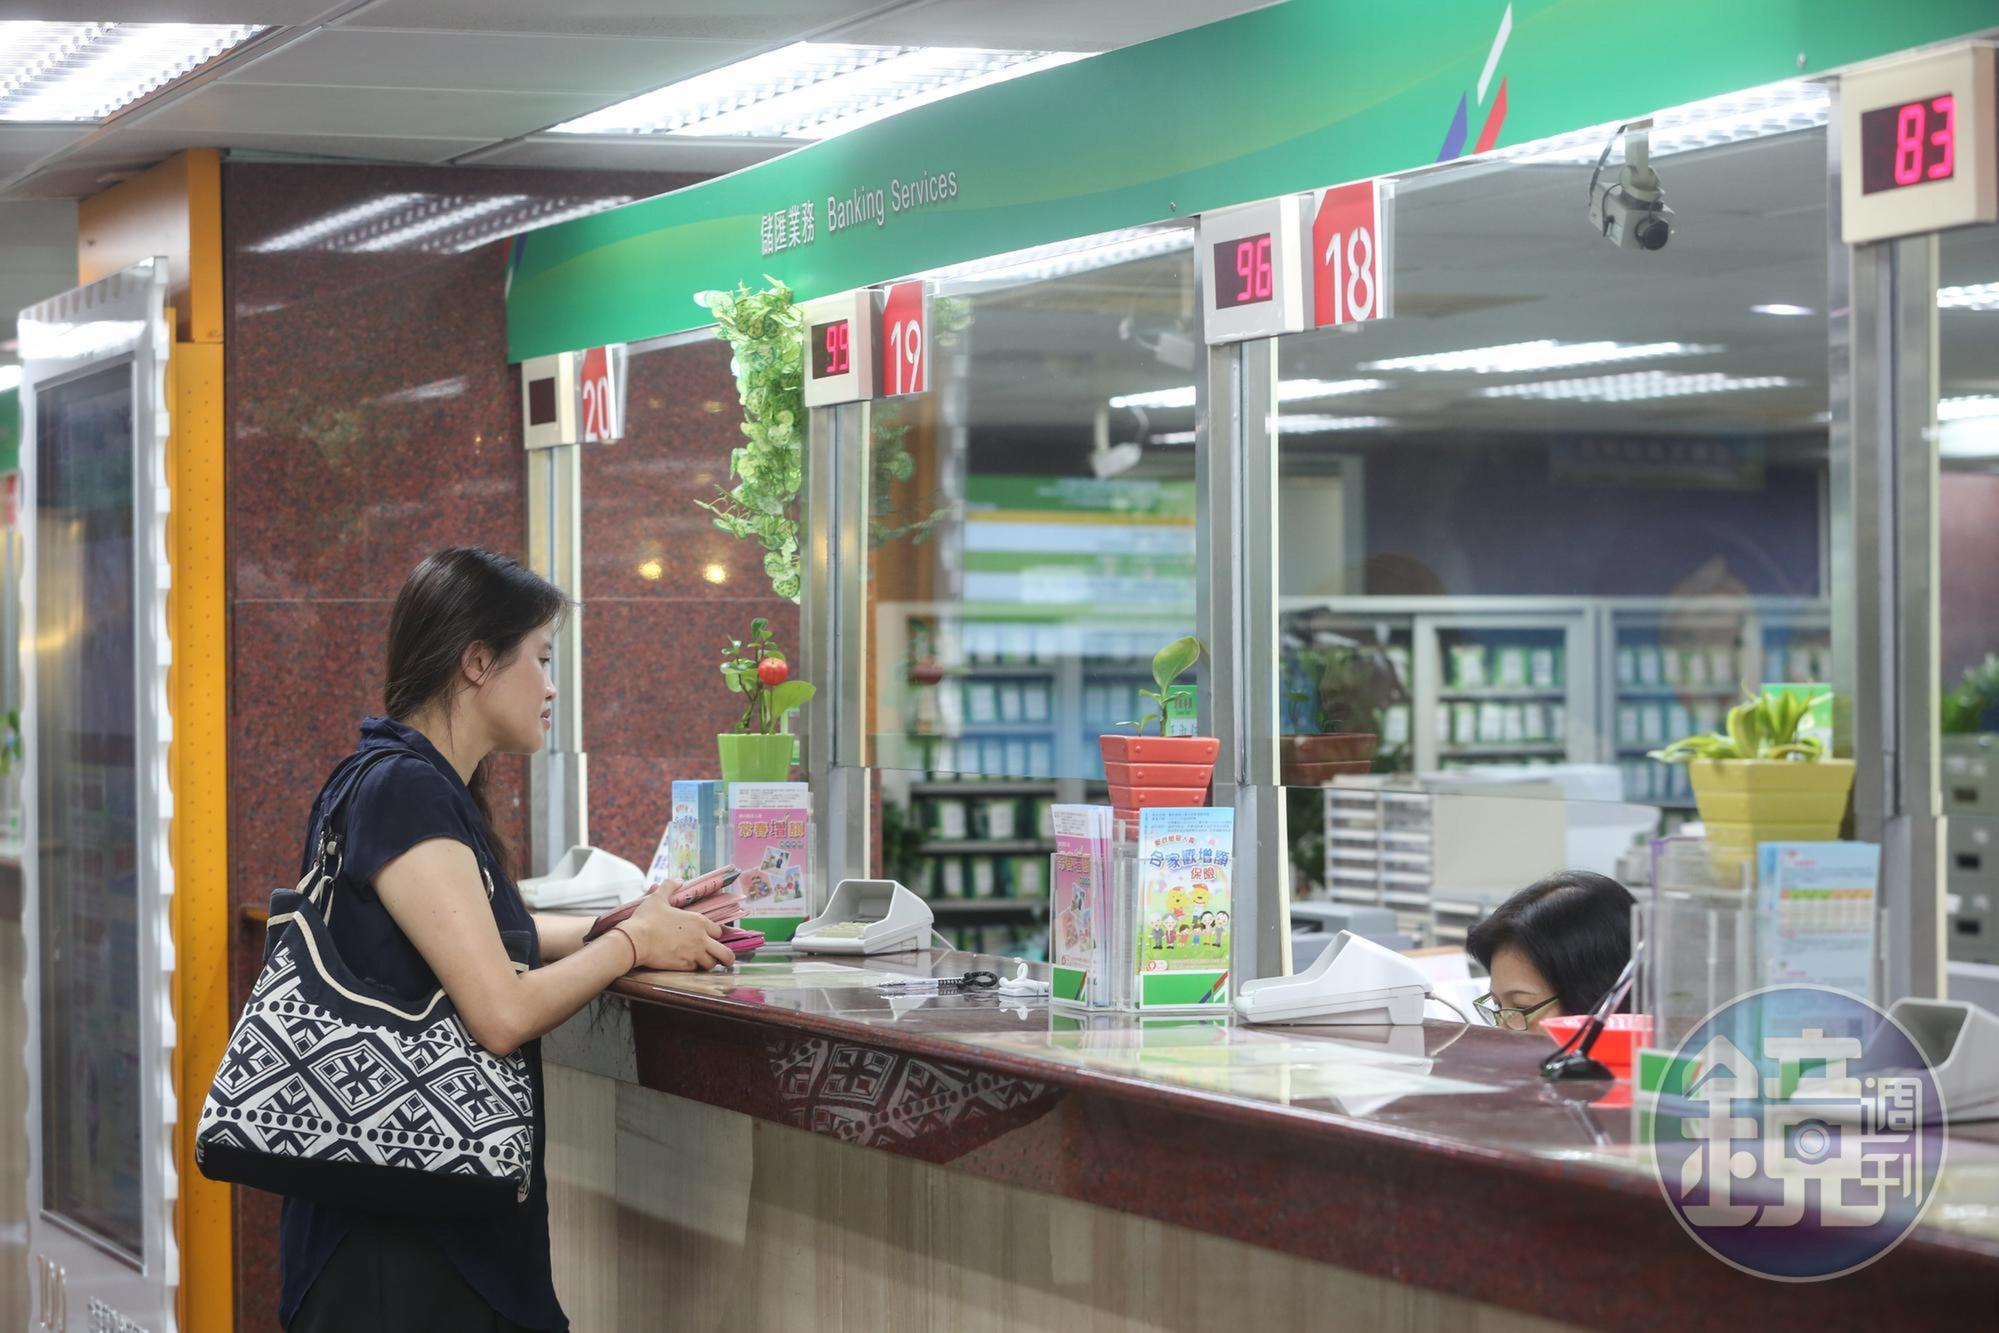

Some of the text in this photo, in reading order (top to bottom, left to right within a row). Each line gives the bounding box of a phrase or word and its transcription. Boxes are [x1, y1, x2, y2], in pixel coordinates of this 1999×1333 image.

[1894, 96, 1955, 185] 83
[760, 170, 958, 256] 儲匯業務 Banking Services
[1237, 237, 1272, 301] 96
[1325, 226, 1375, 324] 18
[826, 322, 849, 373] 99
[890, 319, 922, 395] 19
[582, 375, 611, 443] 20
